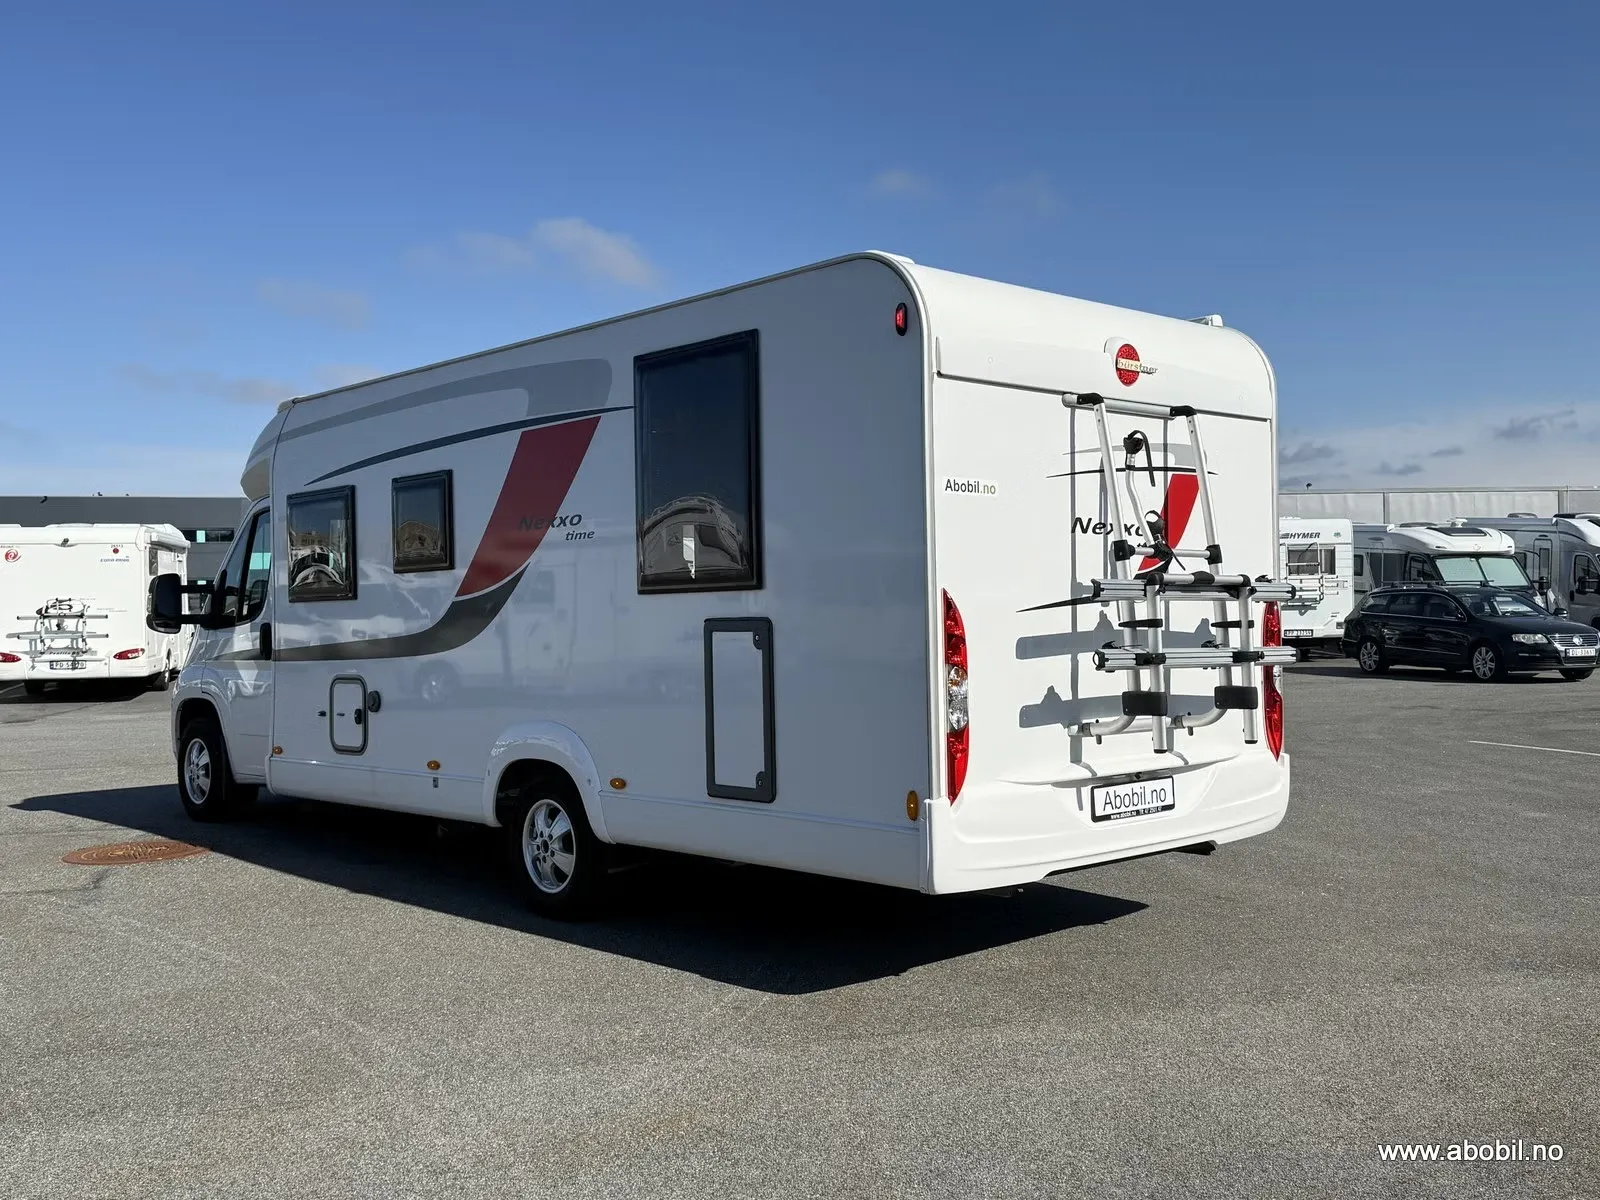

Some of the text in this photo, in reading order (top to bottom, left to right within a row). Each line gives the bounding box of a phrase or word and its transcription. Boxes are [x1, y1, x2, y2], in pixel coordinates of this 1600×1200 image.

[1118, 359, 1158, 374] bürstner
[944, 478, 996, 495] Abobil.no
[518, 514, 583, 532] Nexxo
[565, 530, 595, 541] time
[1103, 785, 1167, 811] Abobil.no
